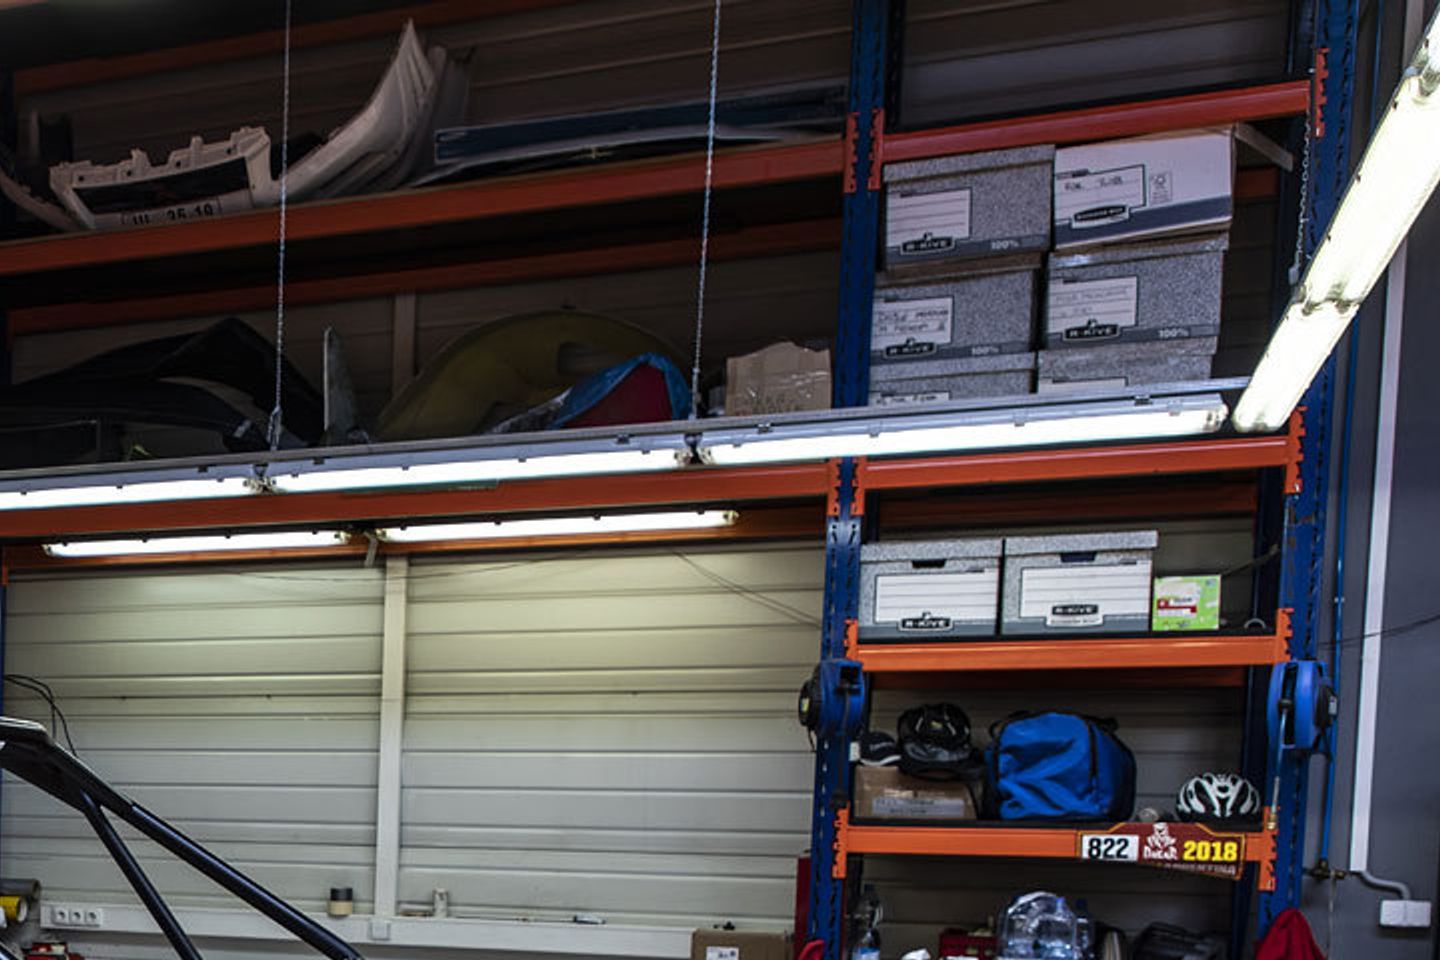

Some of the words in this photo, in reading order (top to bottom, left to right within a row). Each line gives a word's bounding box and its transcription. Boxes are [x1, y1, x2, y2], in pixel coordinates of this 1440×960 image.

[991, 239, 1020, 250] 100%
[1157, 328, 1190, 338] 100%
[1088, 838, 1129, 860] 822
[1143, 846, 1178, 860] DAKAR
[1182, 840, 1239, 862] 2018
